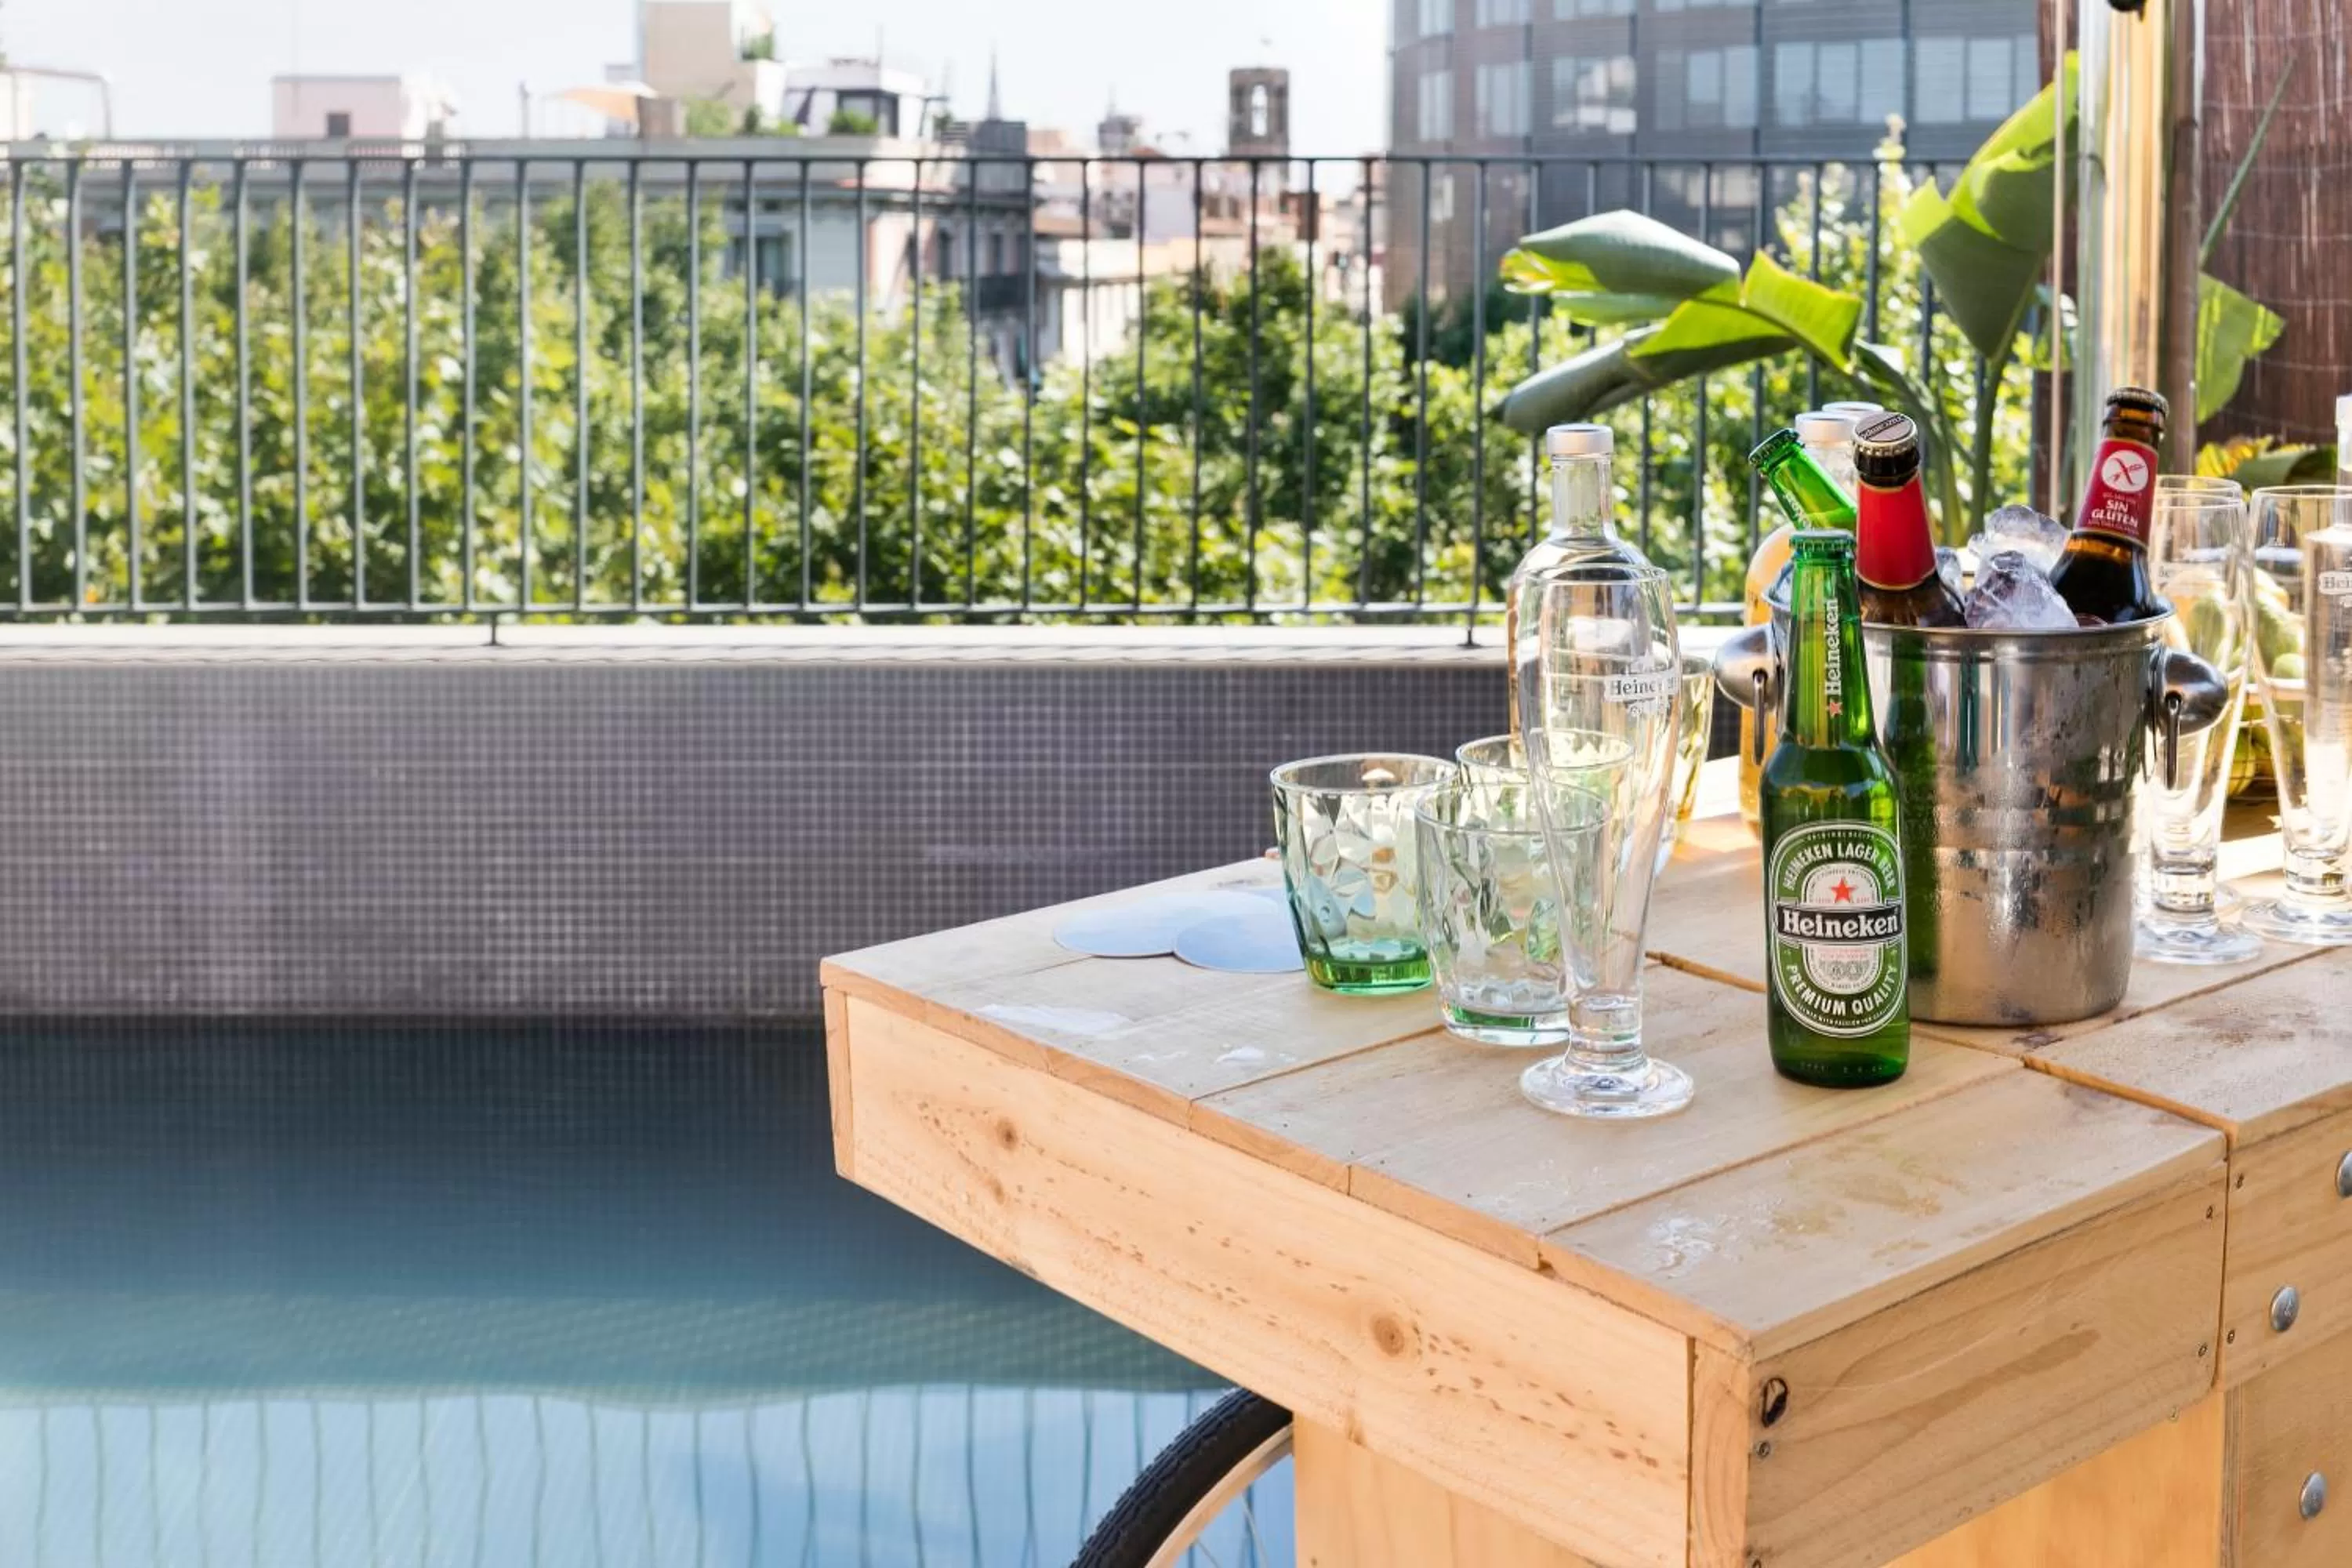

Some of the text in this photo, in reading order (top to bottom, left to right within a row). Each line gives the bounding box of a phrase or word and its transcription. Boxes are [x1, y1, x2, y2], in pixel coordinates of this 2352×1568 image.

[2091, 509, 2139, 528] GLUTEN
[2106, 499, 2129, 513] SIN
[1824, 597, 1842, 695] Heineken
[1783, 842, 1833, 891] HEINEKEN
[1837, 842, 1879, 863] LAGER
[1783, 908, 1899, 938] Heineken
[1786, 964, 1846, 1017] PREMIUM
[1851, 964, 1897, 1016] QUALITY
